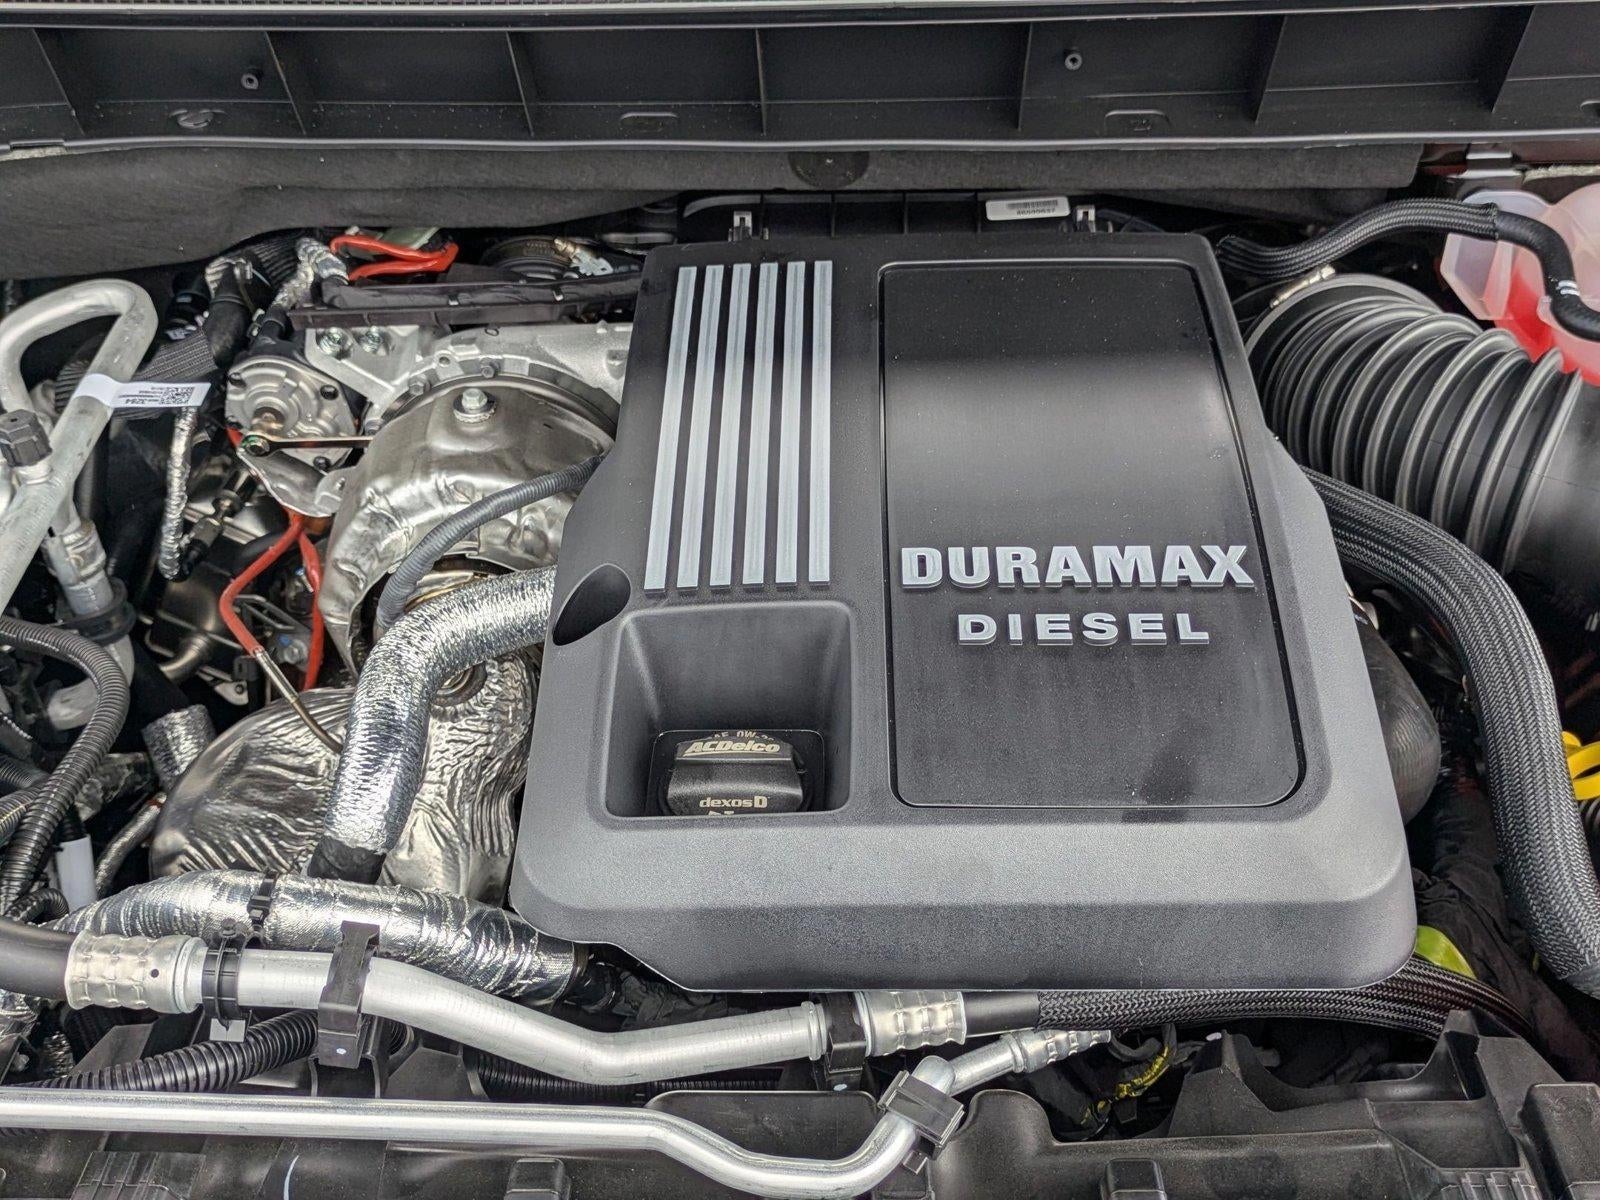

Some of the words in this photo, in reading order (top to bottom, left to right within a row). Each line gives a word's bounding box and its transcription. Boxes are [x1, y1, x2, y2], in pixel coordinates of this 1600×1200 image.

[901, 545, 1254, 588] DURAMAX
[957, 612, 1210, 646] DIESEL
[684, 740, 780, 754] ACDelco
